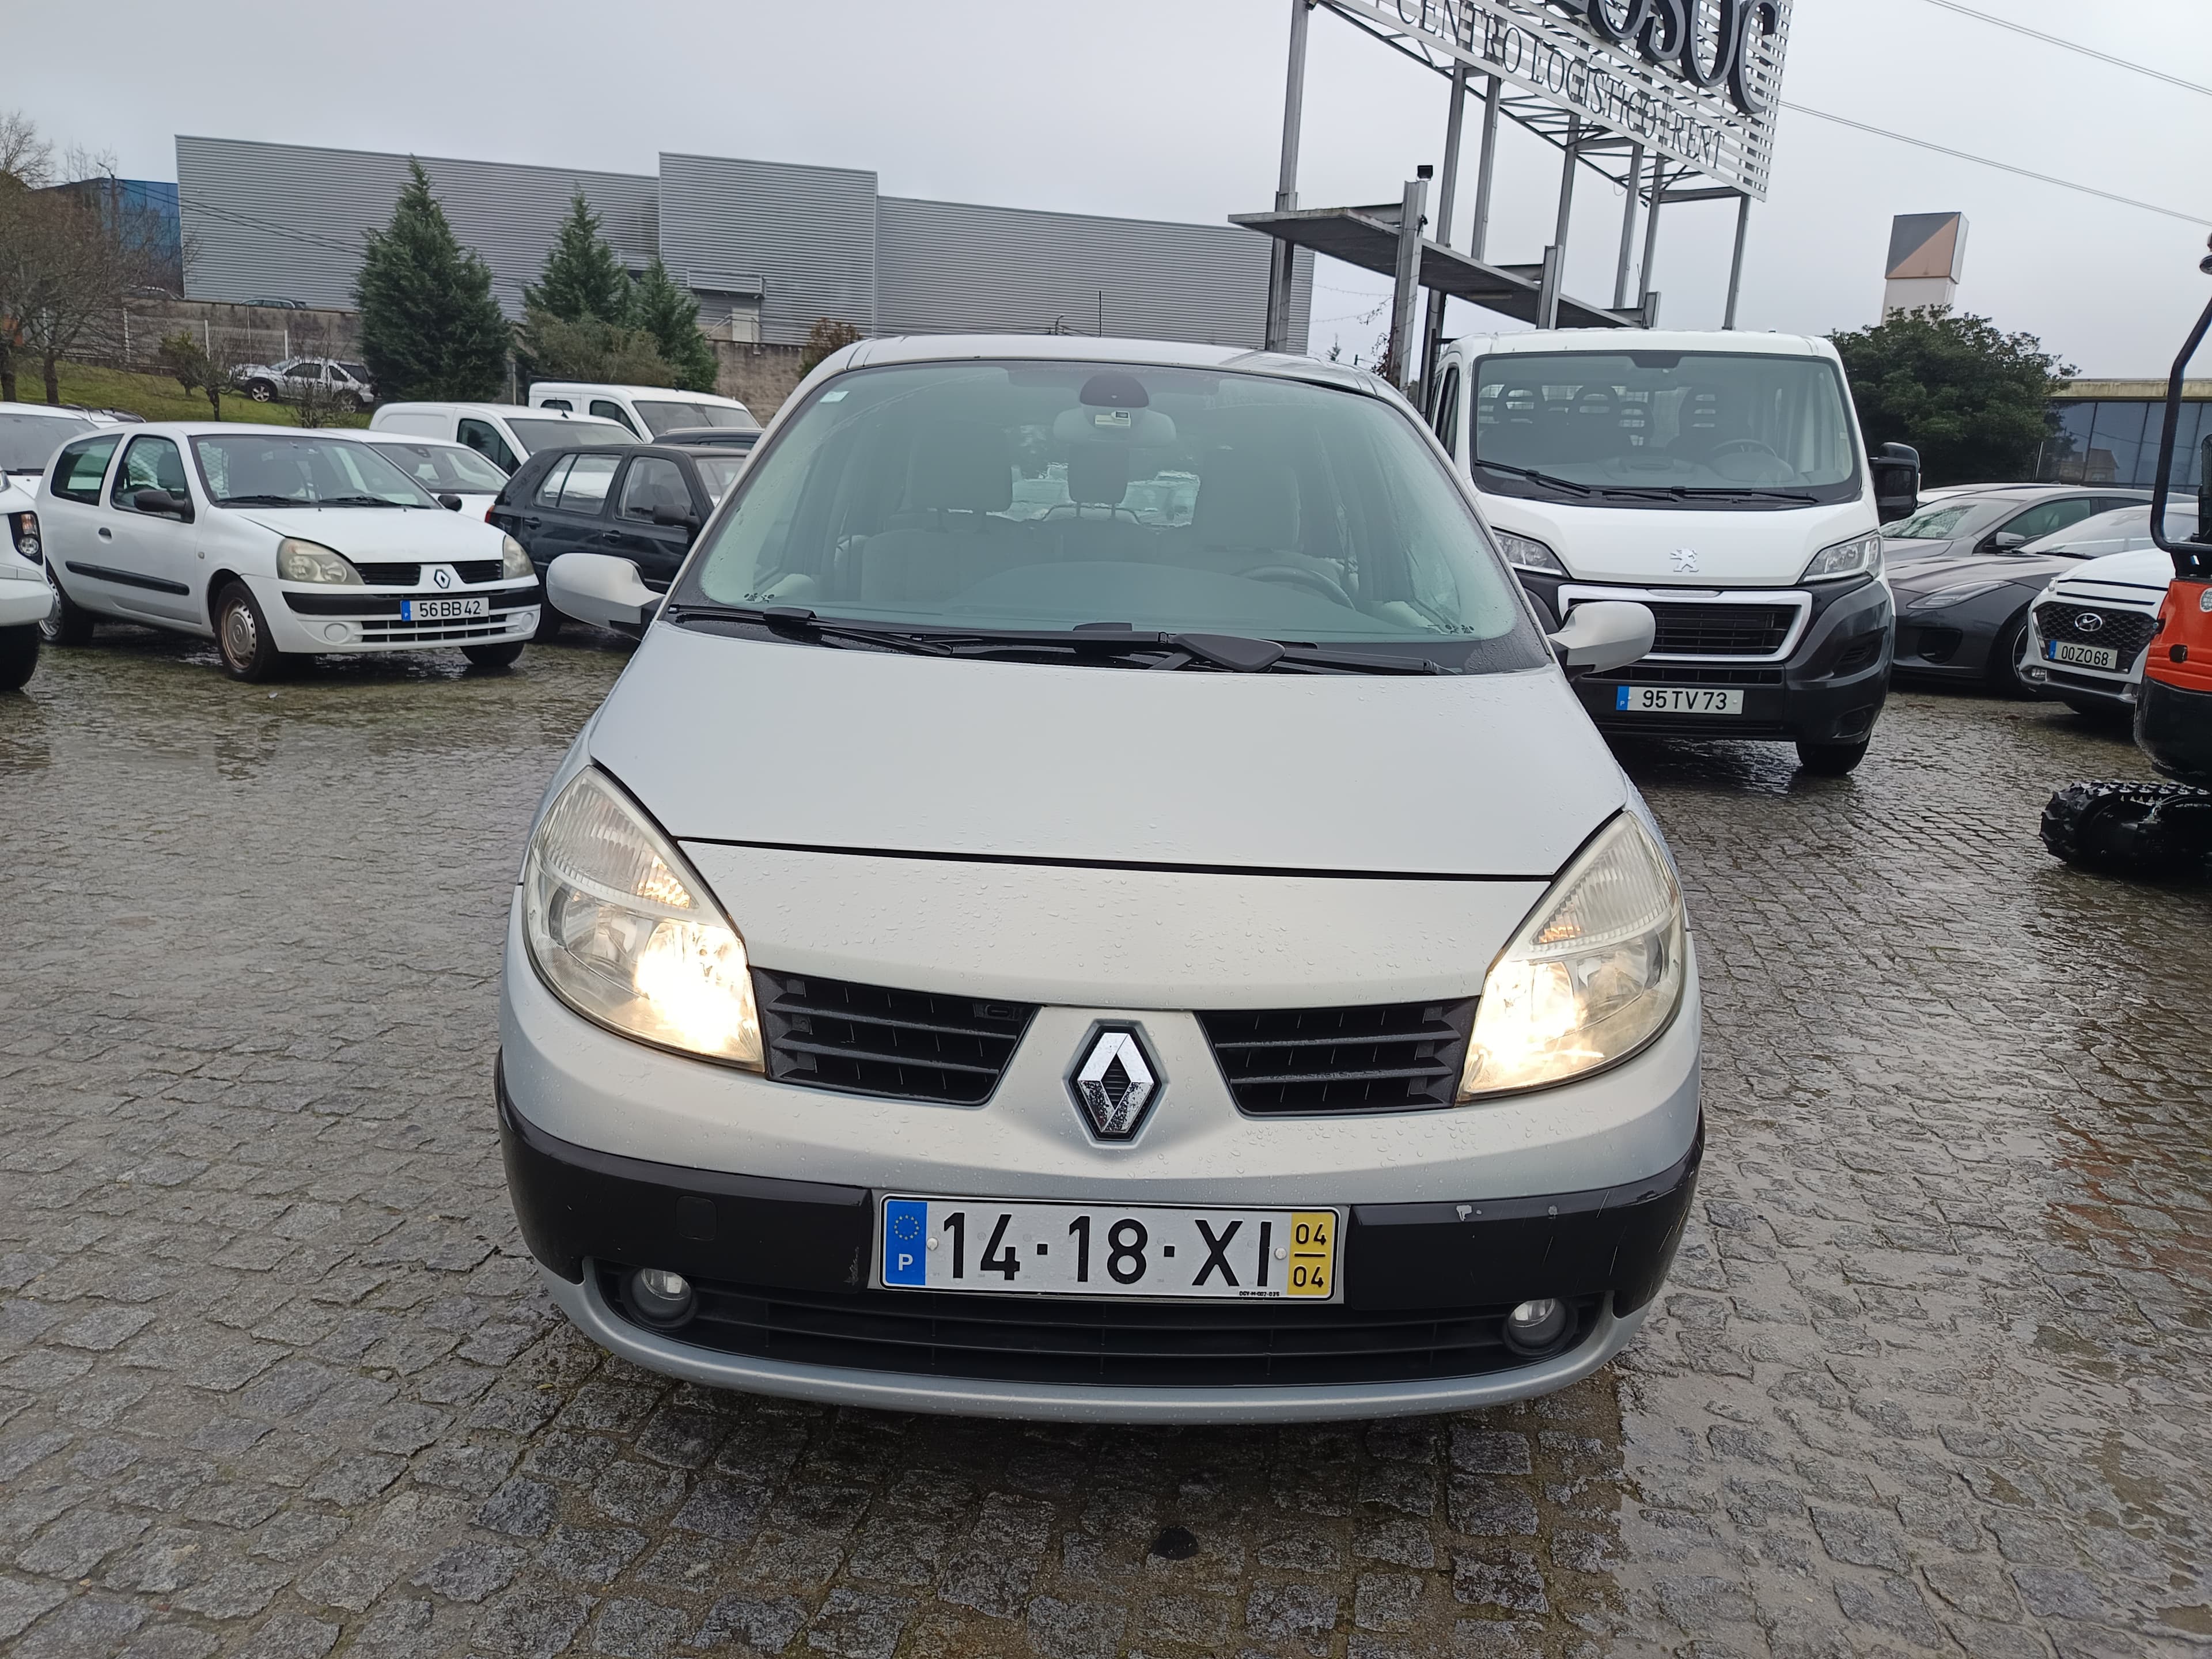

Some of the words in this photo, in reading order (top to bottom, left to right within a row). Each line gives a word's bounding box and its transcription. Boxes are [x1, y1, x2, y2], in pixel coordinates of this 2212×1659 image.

[1671, 111, 1725, 169] RENT
[1296, 1224, 1327, 1245] 04
[898, 1253, 913, 1271] P
[1293, 1266, 1324, 1288] 04
